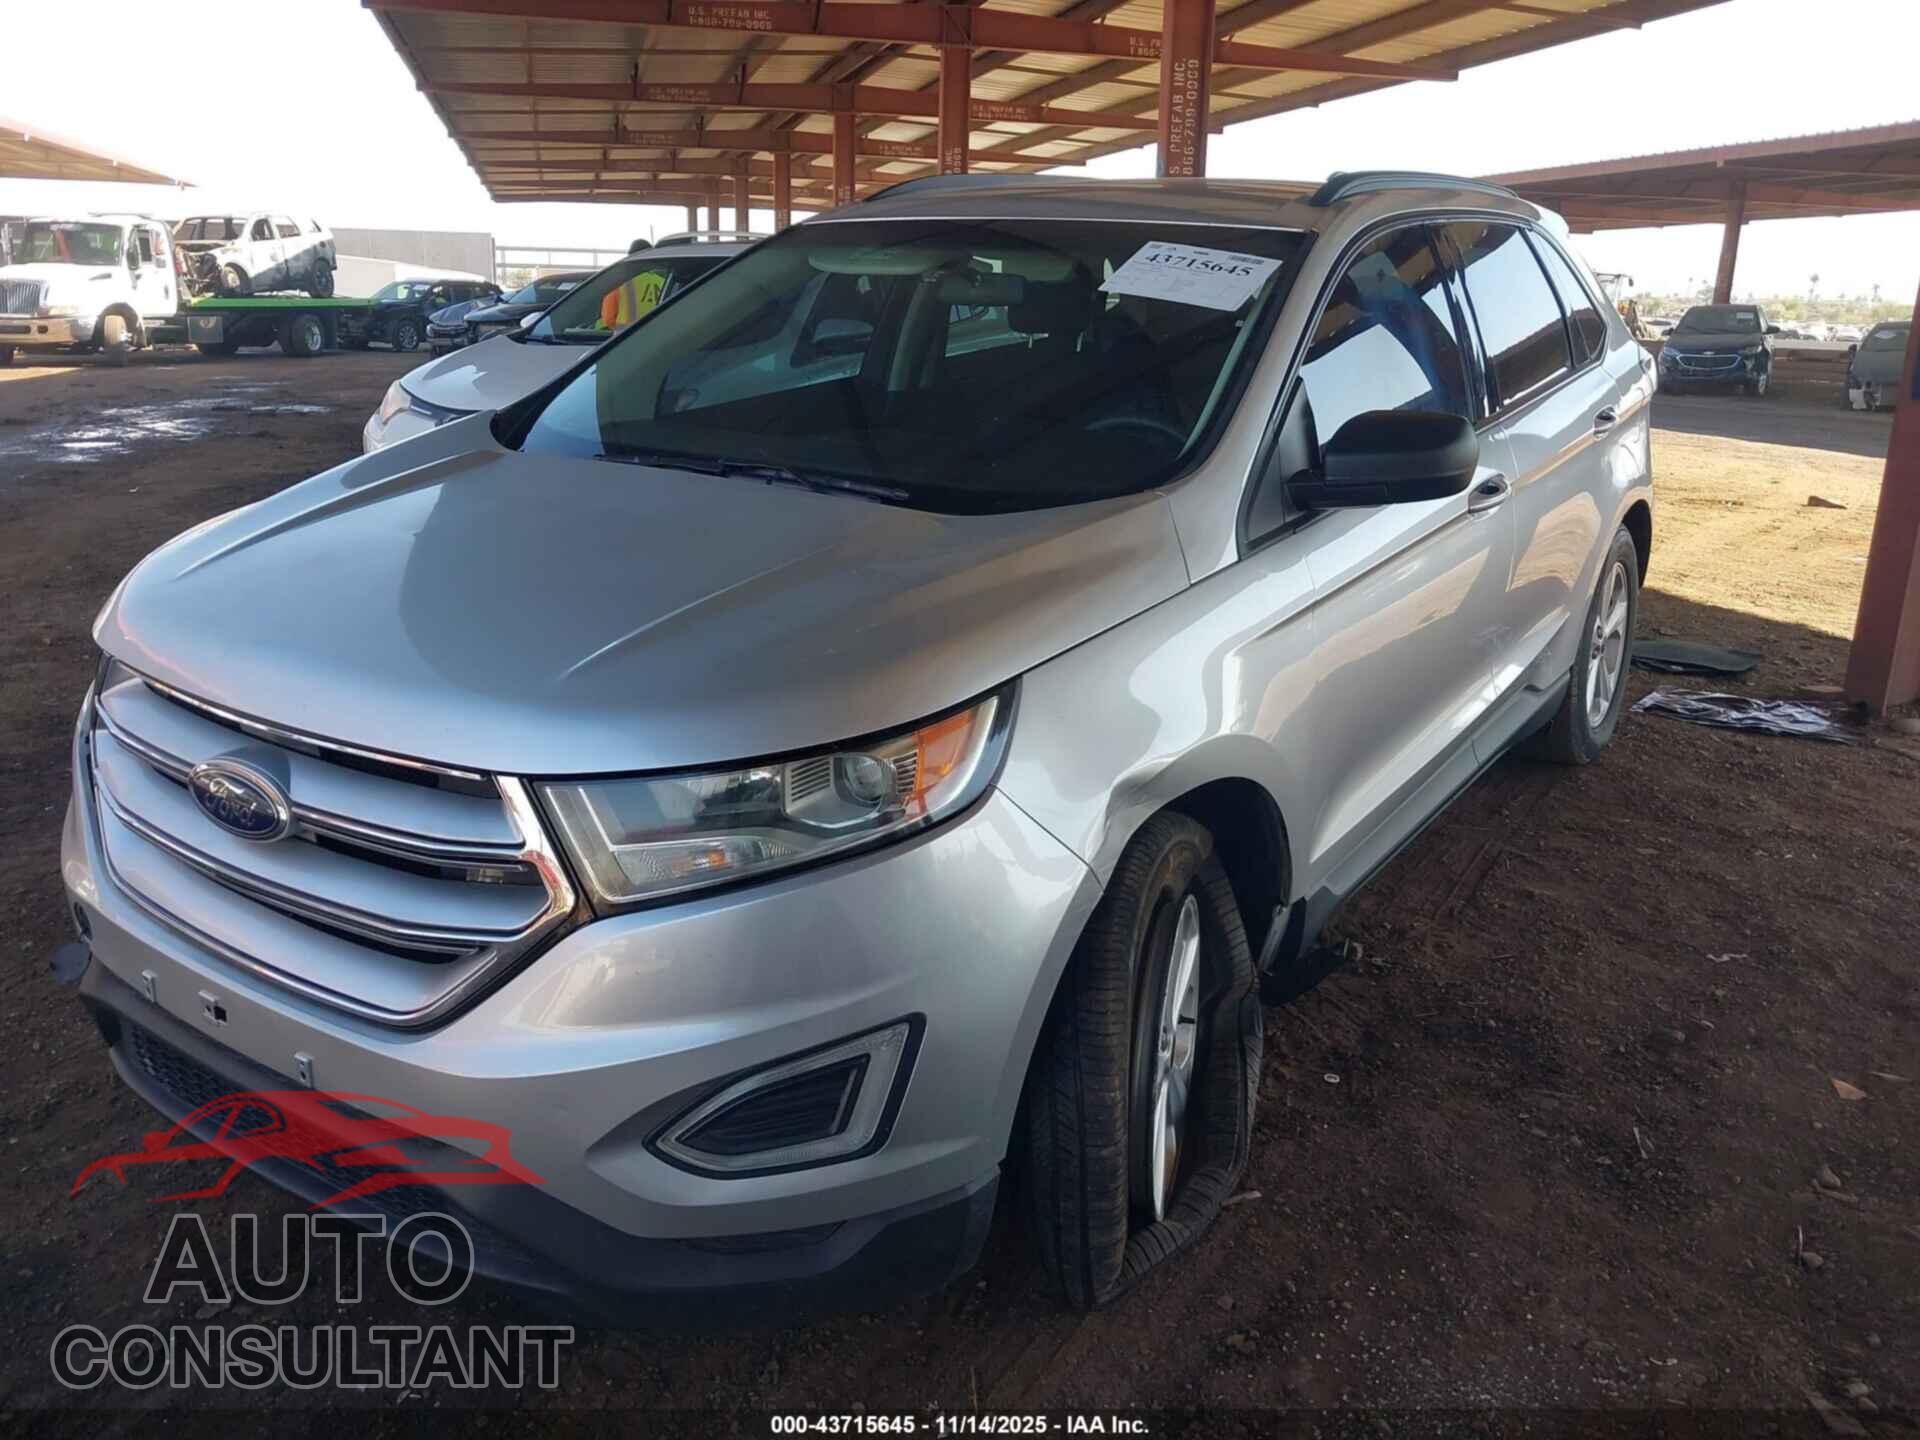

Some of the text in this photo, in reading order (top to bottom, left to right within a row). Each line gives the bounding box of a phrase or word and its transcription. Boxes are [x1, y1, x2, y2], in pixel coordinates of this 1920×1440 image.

[1174, 58, 1186, 87] INC.
[1170, 95, 1184, 153] PREFAB
[1145, 252, 1254, 277] 43715645
